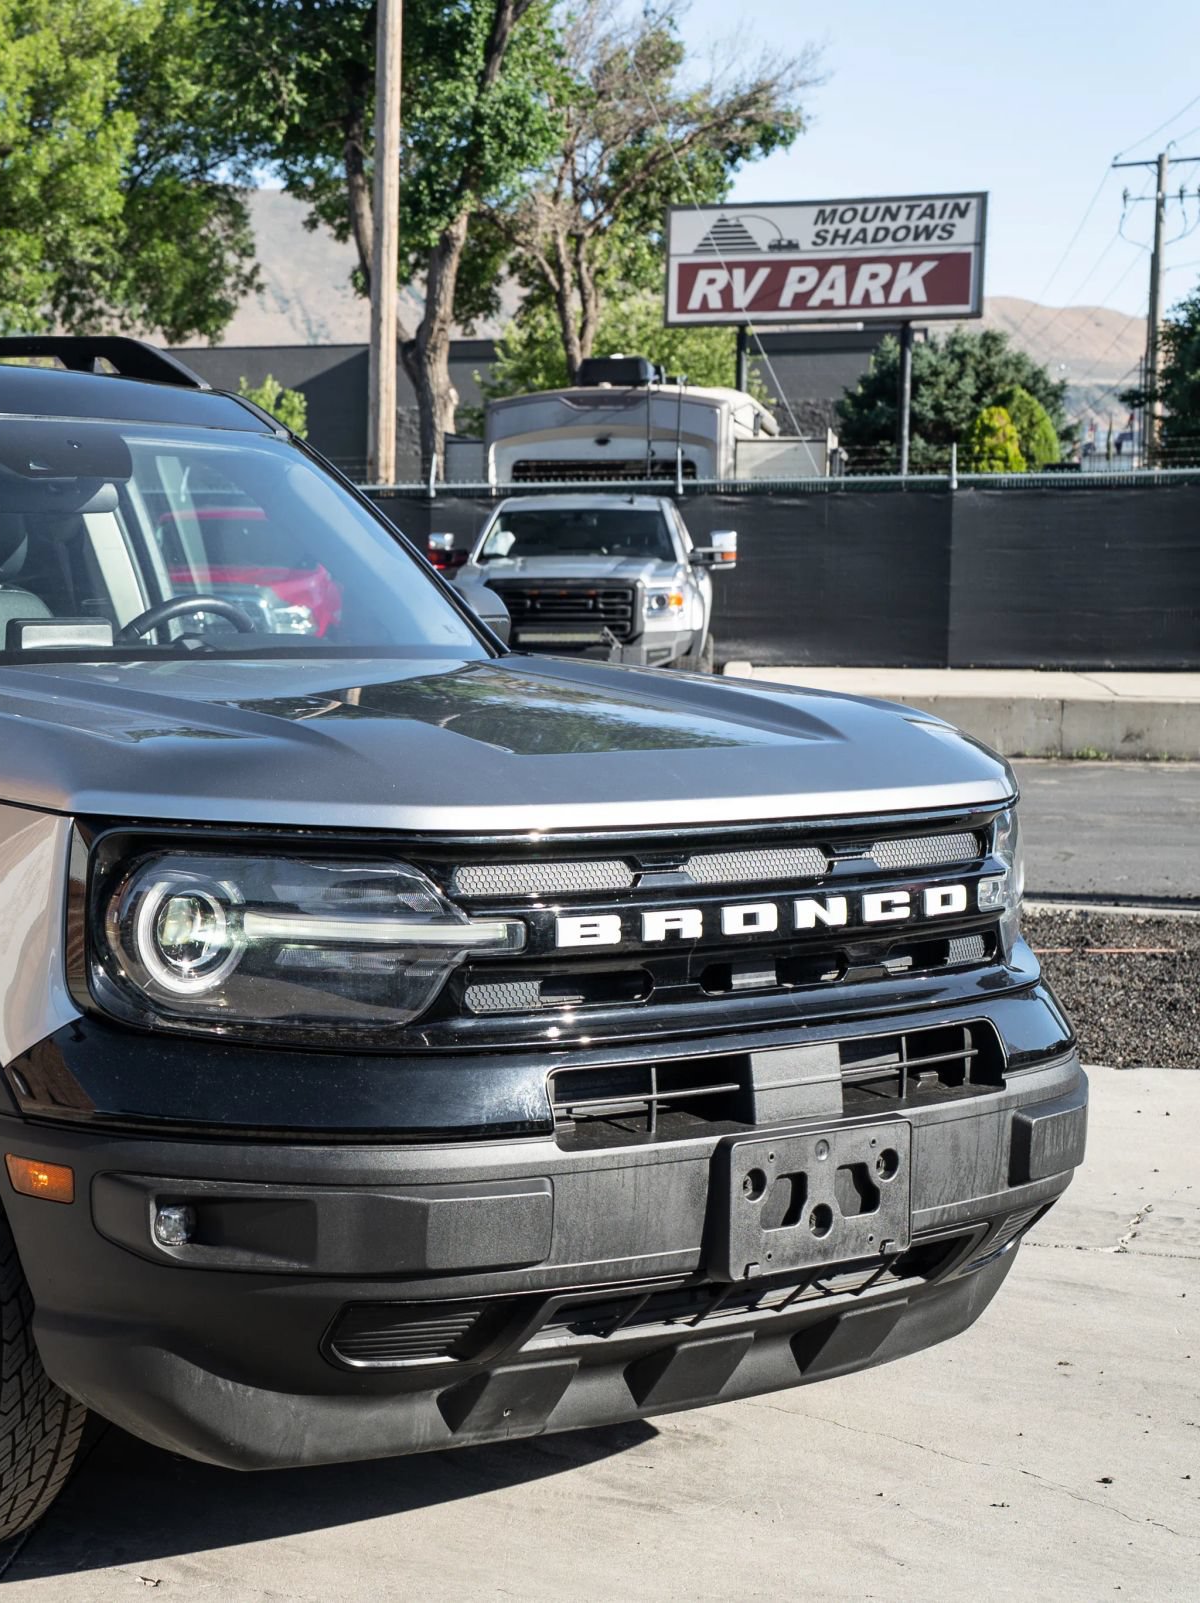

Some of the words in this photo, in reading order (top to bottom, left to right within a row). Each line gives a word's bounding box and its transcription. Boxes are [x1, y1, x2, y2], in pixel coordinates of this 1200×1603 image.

[813, 201, 971, 226] MOUNTAIN
[811, 223, 956, 247] SHADOWS
[687, 267, 771, 310] RV
[778, 260, 939, 308] PARK
[555, 884, 967, 948] BRONCO
